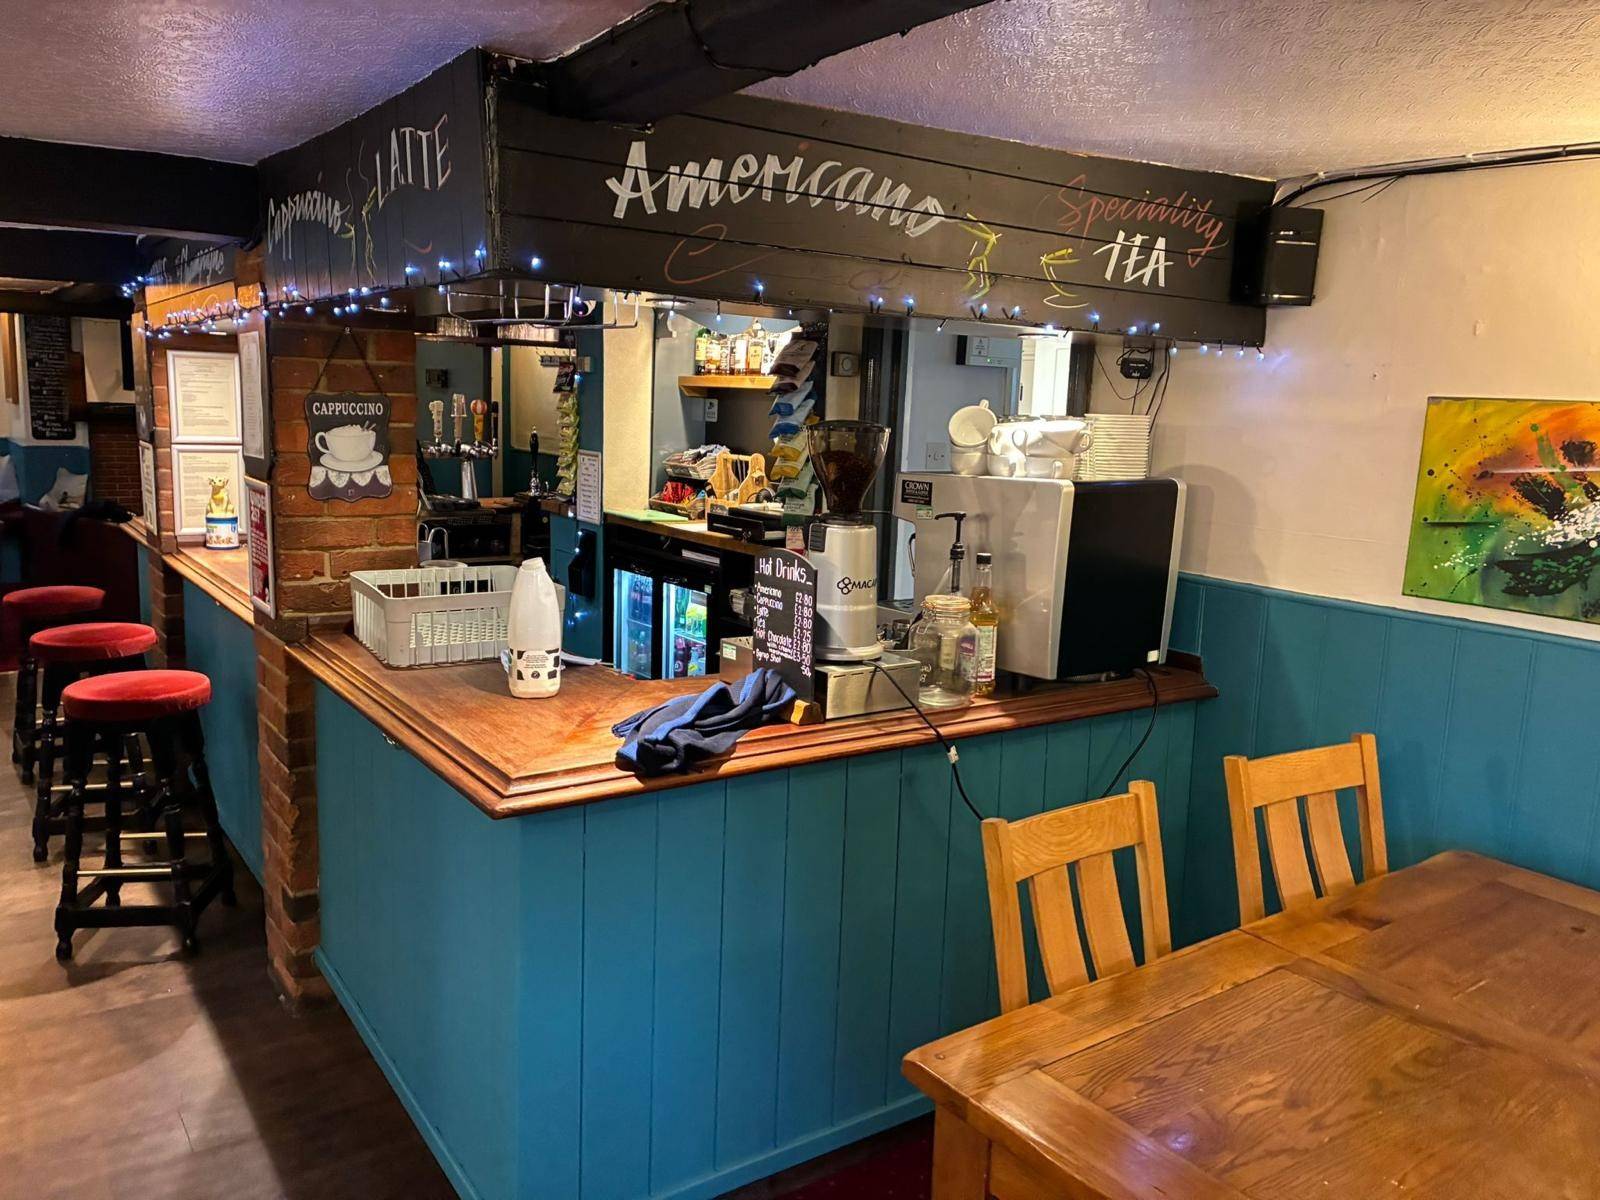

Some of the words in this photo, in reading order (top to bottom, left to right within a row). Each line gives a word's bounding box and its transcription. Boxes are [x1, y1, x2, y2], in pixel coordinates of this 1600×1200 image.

[375, 114, 451, 210] LATTE
[605, 141, 946, 237] Americano
[1056, 174, 1229, 268] Speciality
[1093, 229, 1174, 287] TEA
[312, 402, 384, 415] CAPPUCCINO
[904, 481, 930, 491] CROWN
[759, 557, 773, 576] Hot
[776, 557, 807, 583] Drinks
[756, 582, 782, 598] Americano
[851, 578, 878, 590] MACA
